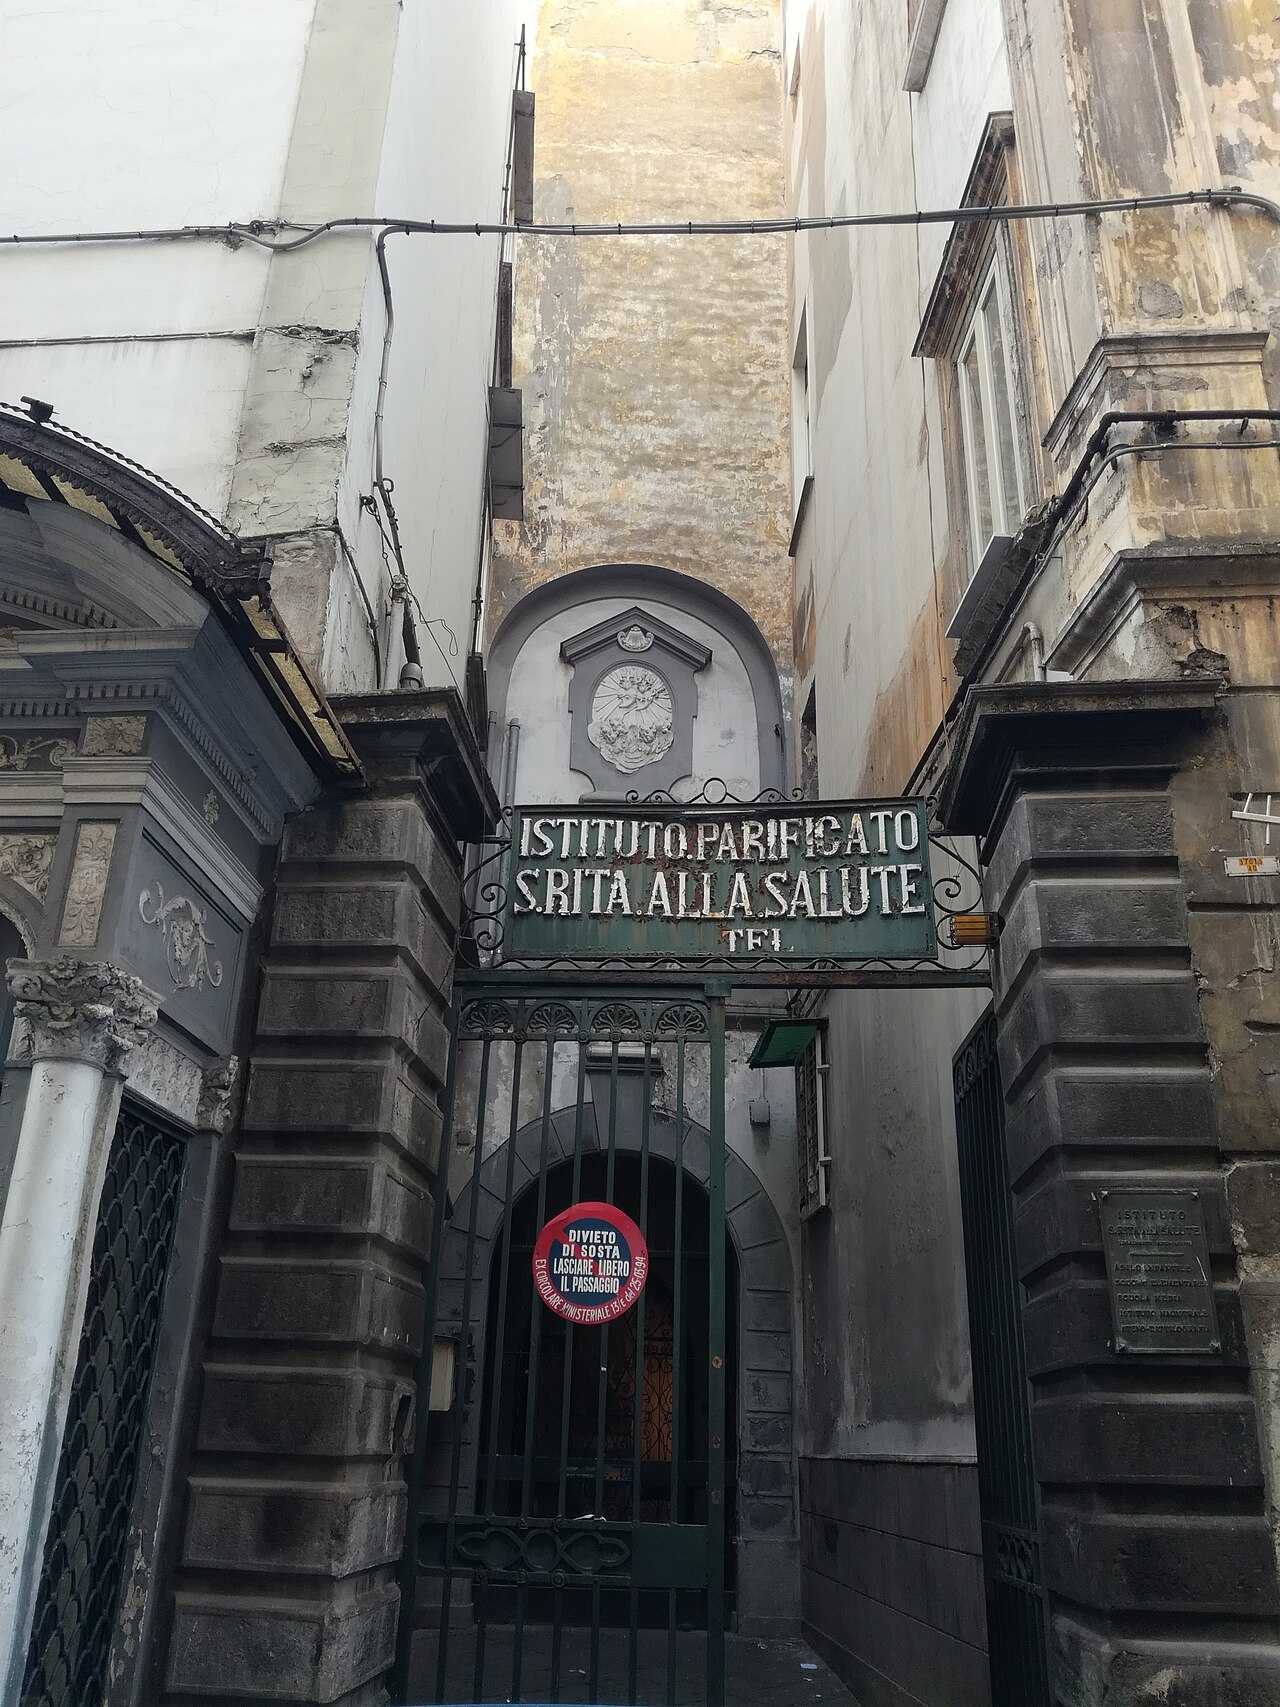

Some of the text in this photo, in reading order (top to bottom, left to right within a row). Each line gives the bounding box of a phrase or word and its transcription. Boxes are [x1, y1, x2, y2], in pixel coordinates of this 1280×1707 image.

[1118, 1209, 1186, 1220] ISTITUTO
[568, 1229, 616, 1244] DIVIETO
[562, 1244, 621, 1259] DI SOSTA
[535, 1258, 547, 1270] EX
[553, 1258, 630, 1277] LASCIARE LIBERO
[535, 1270, 564, 1310] CIRCOLARE
[560, 1276, 620, 1294] IL PASSAGGIO
[625, 1290, 637, 1303] del
